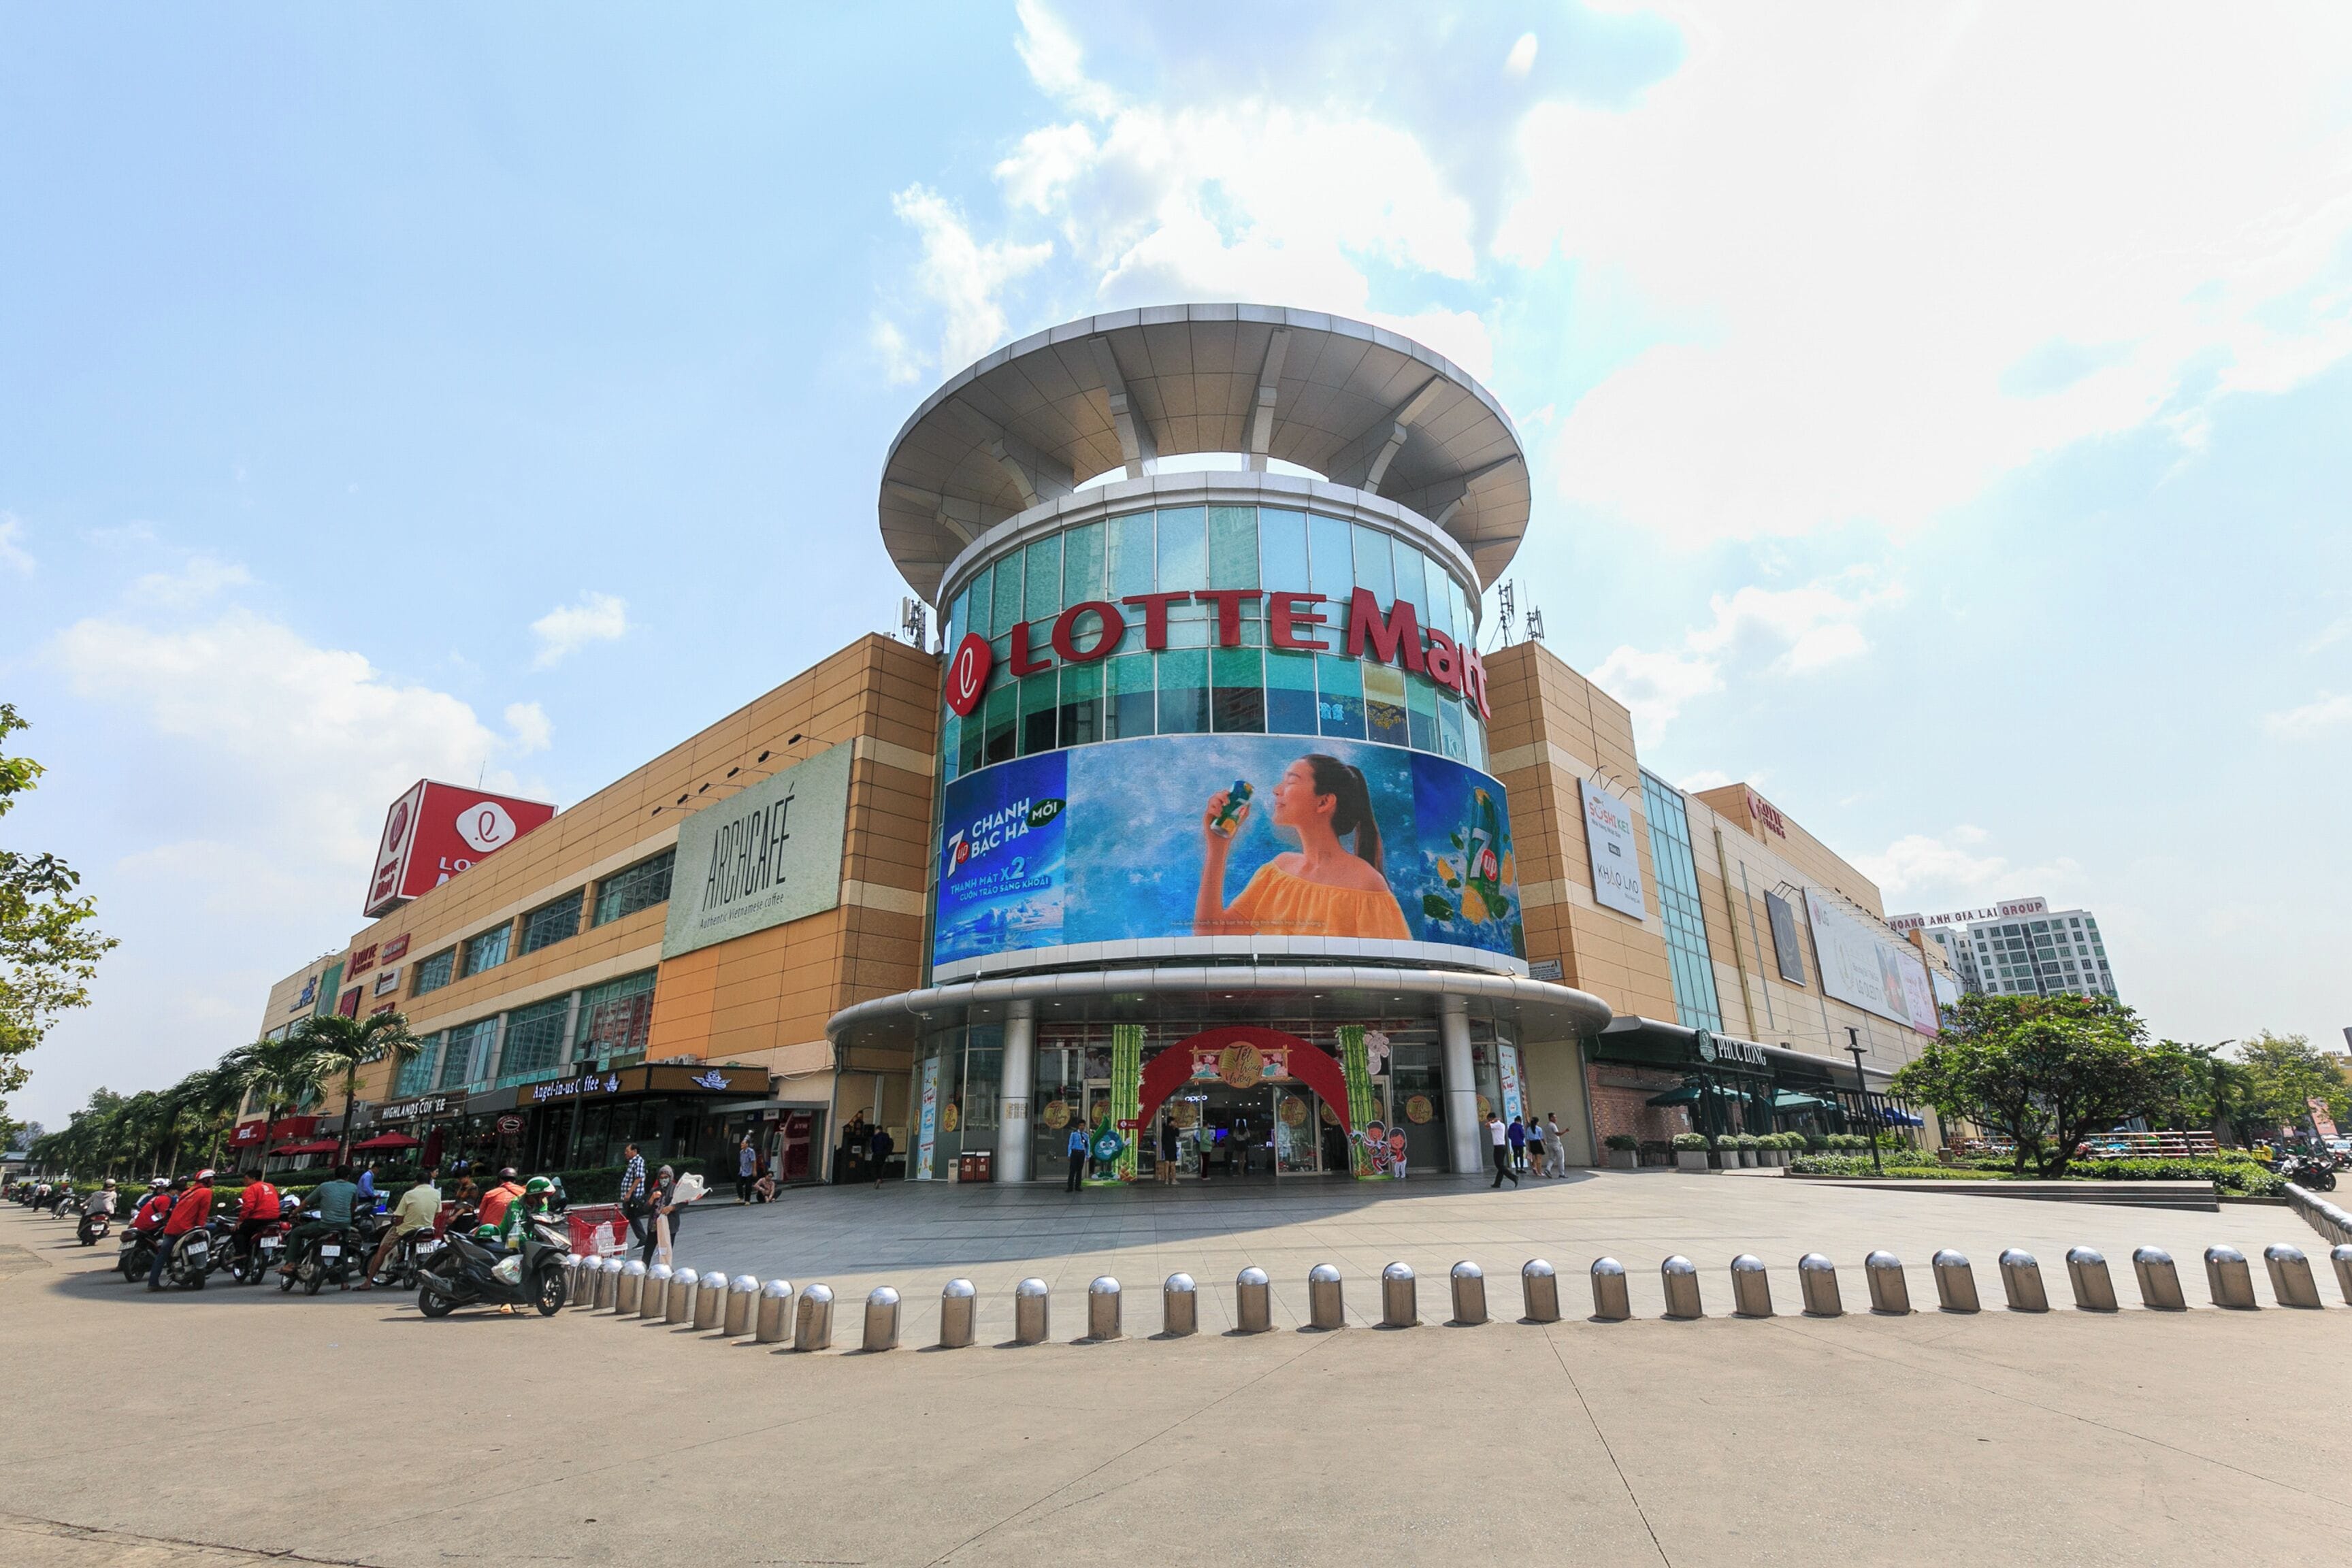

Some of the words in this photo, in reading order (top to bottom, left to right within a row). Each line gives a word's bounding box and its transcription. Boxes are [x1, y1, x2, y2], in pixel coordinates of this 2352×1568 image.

[1010, 589, 1329, 677] LOTTE
[1347, 586, 1490, 719] Mart
[972, 797, 1030, 838] CHANH
[1032, 800, 1058, 821] MỚI
[1589, 802, 1617, 828] SUSHI
[1617, 819, 1630, 834] KEI
[702, 781, 795, 912] ARCHCAFÉ
[971, 830, 1001, 859] BẠC
[951, 879, 977, 895] THANH
[700, 913, 728, 930] Authentic
[729, 901, 763, 921] Vietnamese
[764, 893, 784, 908] coffee
[1890, 917, 1925, 931] HOANG
[1930, 914, 1950, 925] ANH
[1955, 911, 1974, 921] GIA
[1978, 908, 1997, 918] LAI
[2002, 902, 2042, 916] GROUP
[1743, 1044, 1766, 1066] LONG
[533, 1080, 574, 1102] Angel-in-us
[575, 1075, 600, 1093] Cffee
[382, 1102, 419, 1120] HIGHLANDS
[419, 1098, 446, 1114] COFEE
